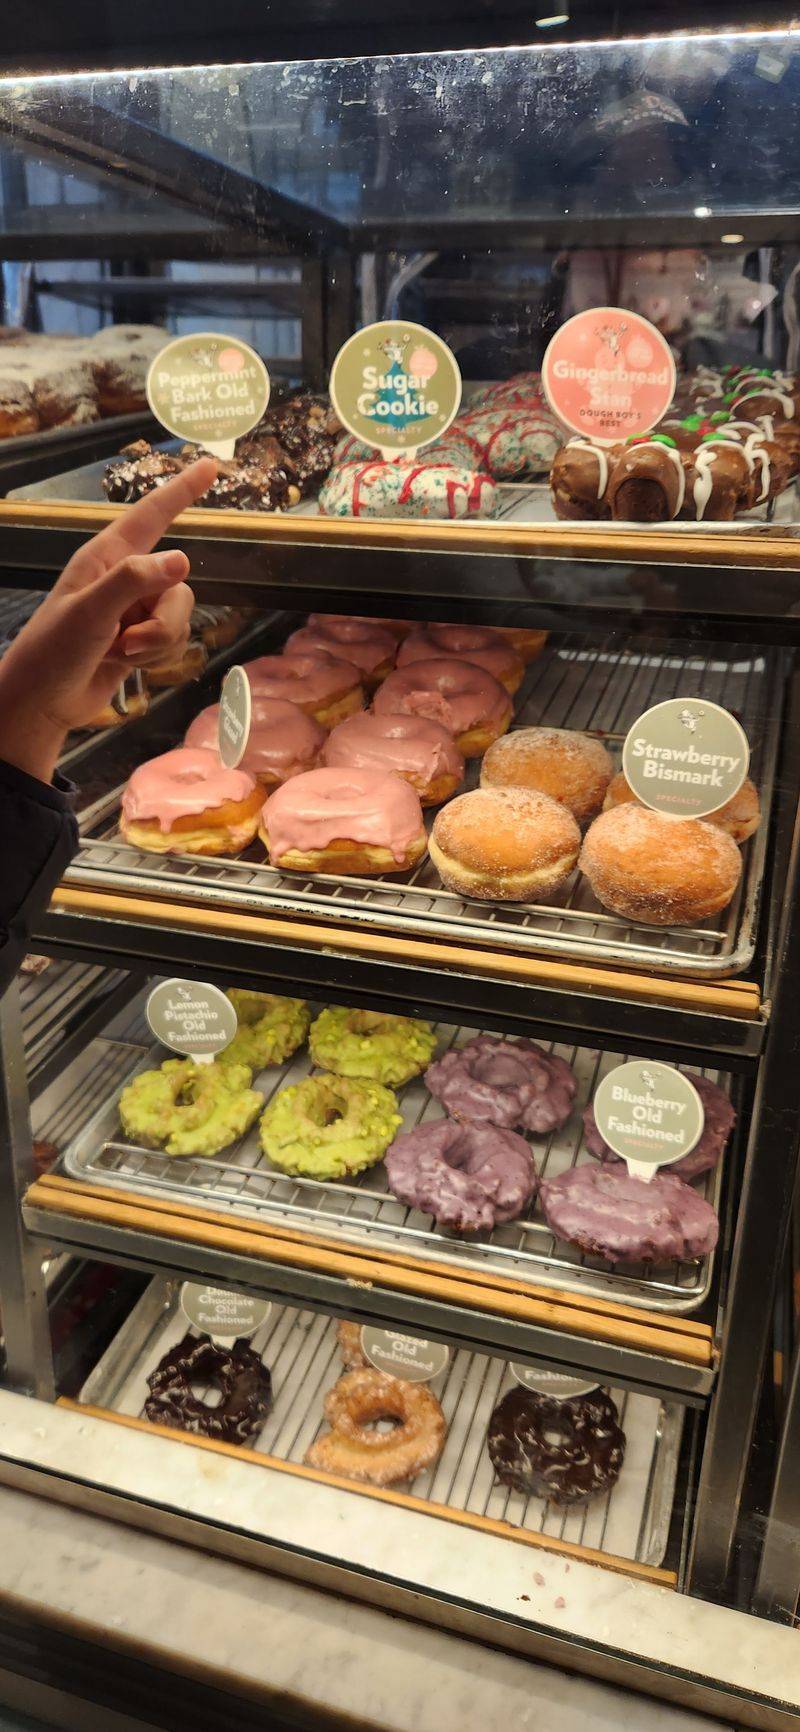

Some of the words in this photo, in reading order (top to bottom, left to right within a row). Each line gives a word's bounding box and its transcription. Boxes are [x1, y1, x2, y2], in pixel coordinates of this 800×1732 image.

[158, 367, 256, 388] Peppermint
[362, 366, 431, 395] Sugar
[552, 360, 669, 386] Gingerbread
[172, 387, 211, 404] Bark
[216, 382, 249, 399] Old
[171, 400, 256, 422] Fashioned
[357, 392, 439, 416] Cookie
[580, 409, 614, 419] DOUGH
[600, 420, 621, 428] BEST
[632, 738, 741, 774] Strawberry
[642, 759, 724, 788] Bismark
[164, 1009, 218, 1021] Pistachio
[167, 1000, 209, 1010] Lemon
[183, 1020, 206, 1031] Old
[168, 1030, 227, 1042] Fashioned
[611, 1085, 687, 1116] Blueberry
[632, 1105, 663, 1124] Old
[607, 1115, 685, 1144] Fashioned
[199, 1295, 254, 1306] Chocolate
[216, 1305, 237, 1314] Old
[198, 1312, 253, 1324] Fashioned
[371, 1345, 434, 1372] Fashioned
[392, 1341, 417, 1356] Old
